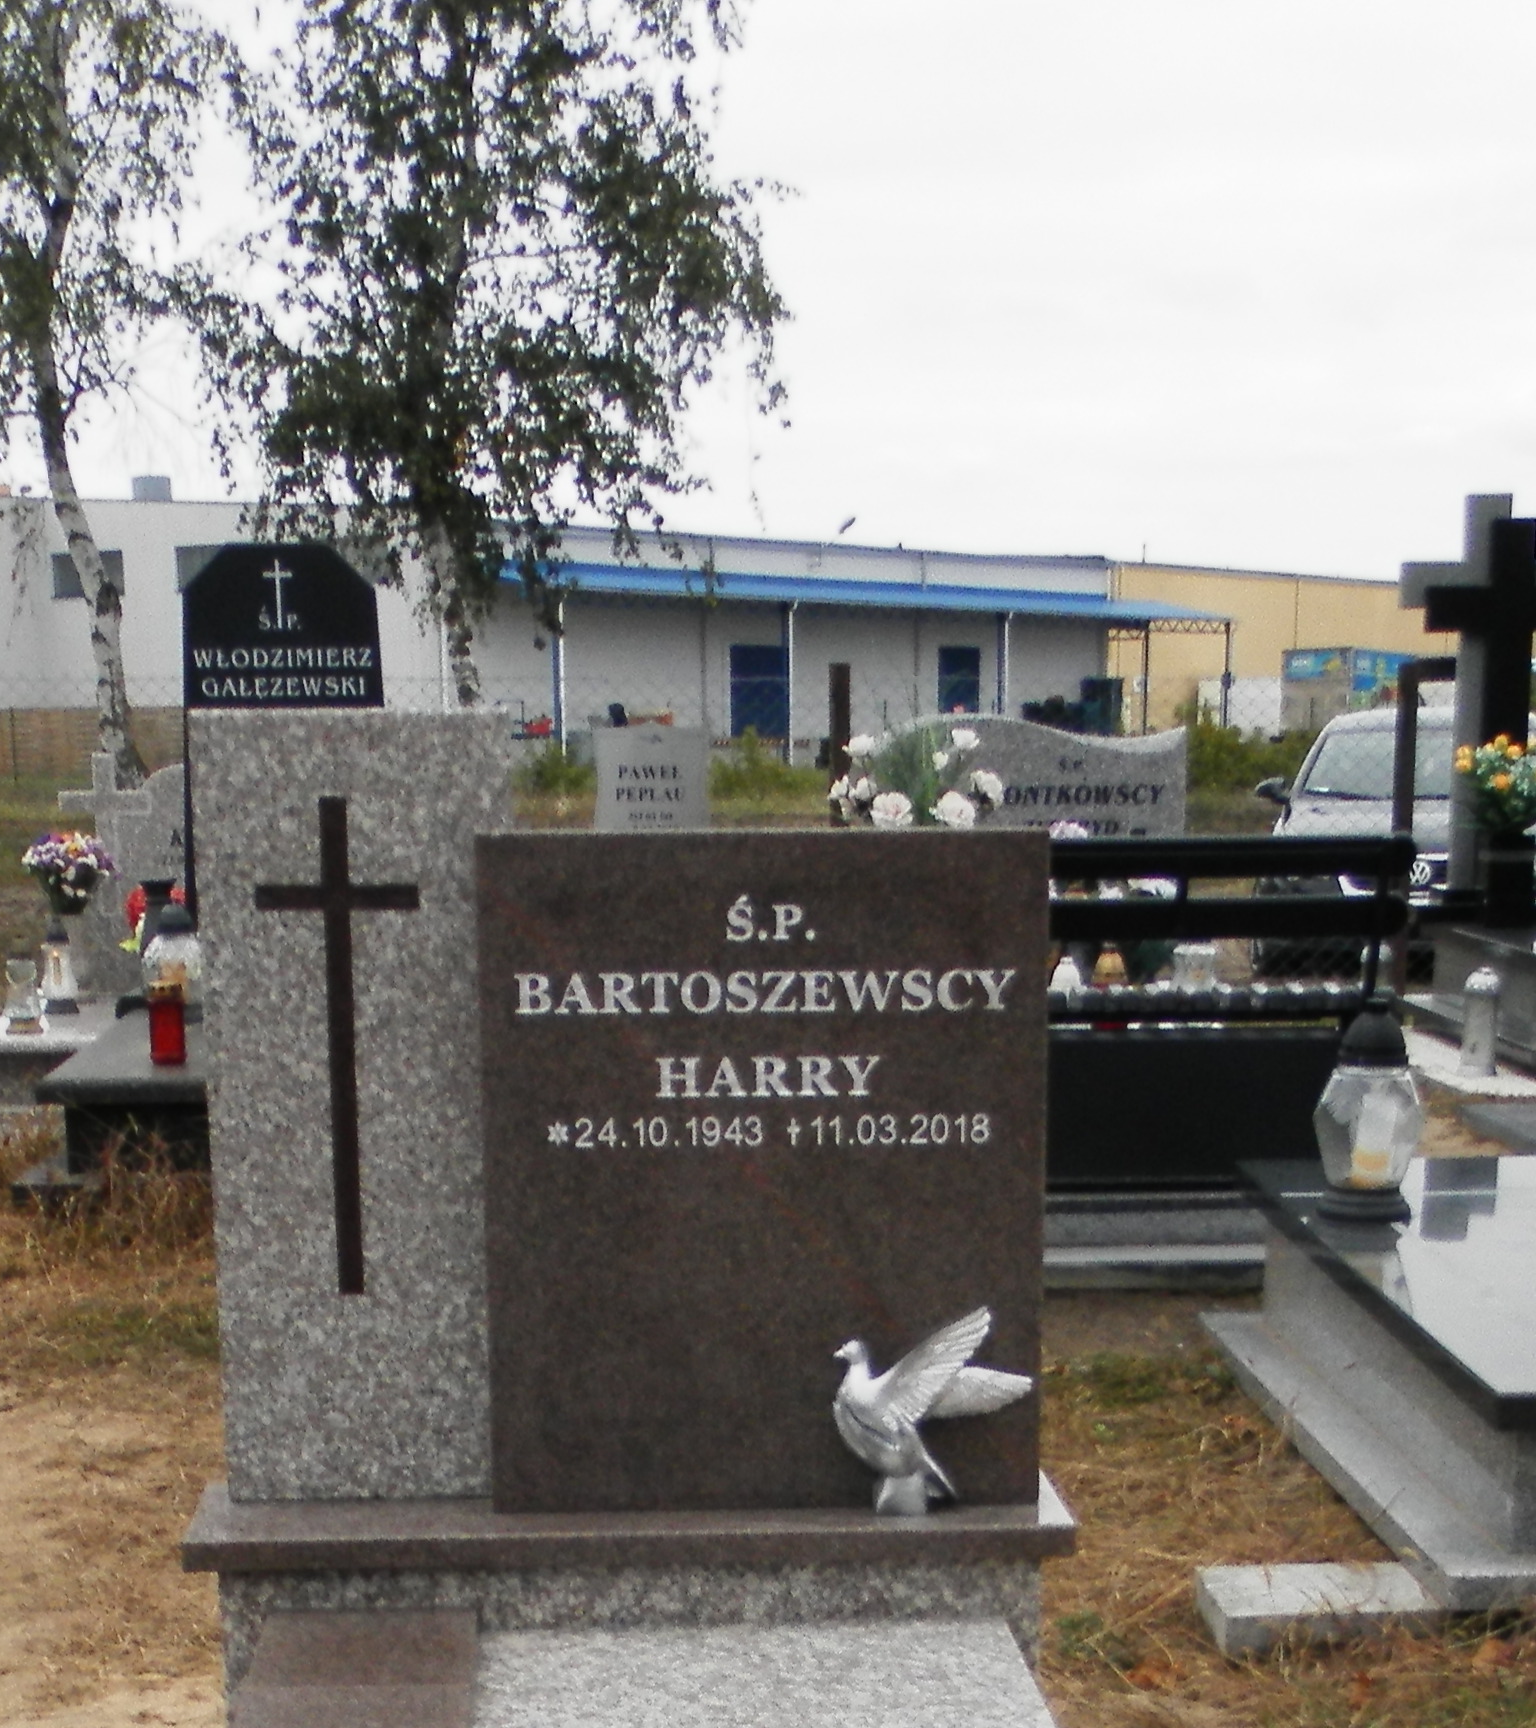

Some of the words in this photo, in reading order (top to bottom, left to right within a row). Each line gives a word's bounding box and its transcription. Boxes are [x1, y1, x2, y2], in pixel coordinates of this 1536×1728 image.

[193, 648, 373, 669] WŁODZIMIERZ
[725, 894, 817, 943] Ś.P.
[514, 967, 1016, 1016] BARTOSZEWSCY
[655, 1054, 881, 1099] HARRY
